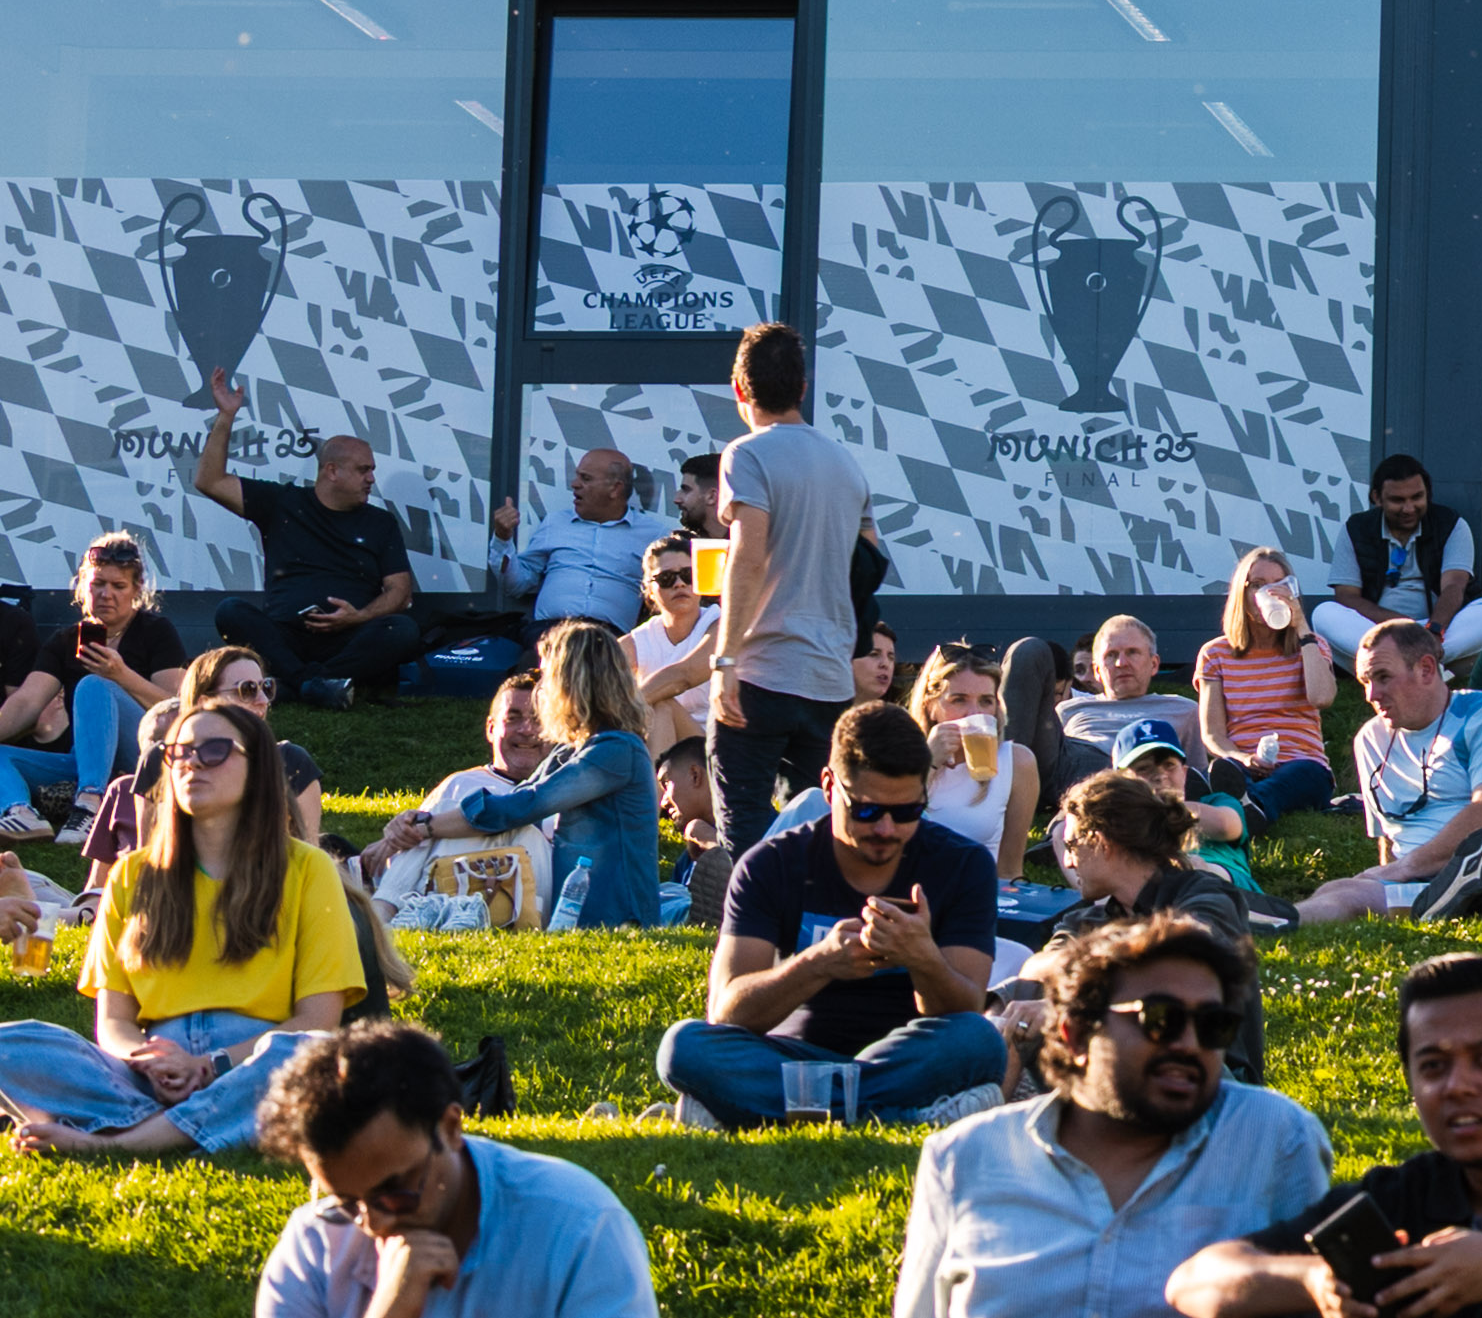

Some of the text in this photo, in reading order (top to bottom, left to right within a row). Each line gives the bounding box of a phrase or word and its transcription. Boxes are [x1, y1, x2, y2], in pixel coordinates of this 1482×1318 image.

[635, 270, 683, 285] UEFA
[583, 291, 734, 309] CHAMPIONS
[609, 313, 706, 330] LEAGUE
[110, 427, 320, 459] MUNH 25
[1153, 431, 1199, 464] 25
[1045, 472, 1141, 487] FINAL
